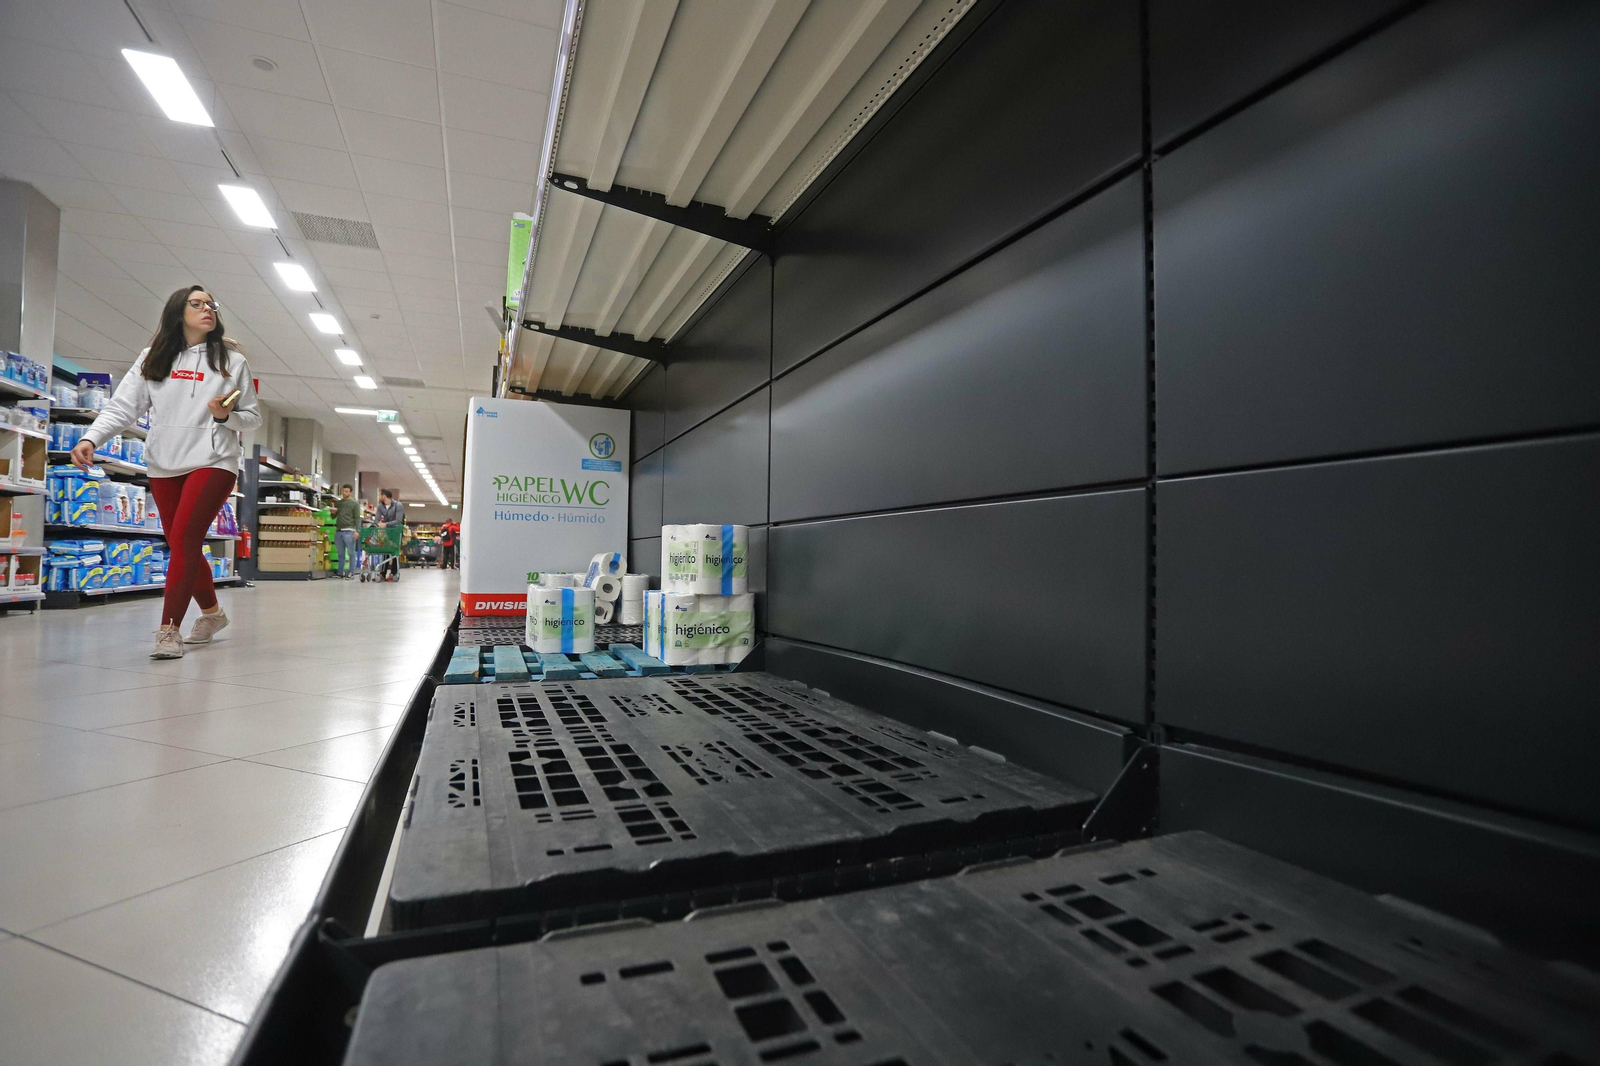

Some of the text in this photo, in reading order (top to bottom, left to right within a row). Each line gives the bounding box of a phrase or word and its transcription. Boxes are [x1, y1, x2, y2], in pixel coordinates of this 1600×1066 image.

[492, 475, 610, 506] PAPEL WC
[496, 492, 561, 504] HIGIÉNICO
[494, 510, 606, 524] Húmedo Húmido
[669, 552, 696, 567] higiénico
[705, 554, 743, 567] higiénico
[526, 571, 540, 581] 10
[544, 617, 585, 629] higiénico
[675, 622, 730, 639] higiénico
